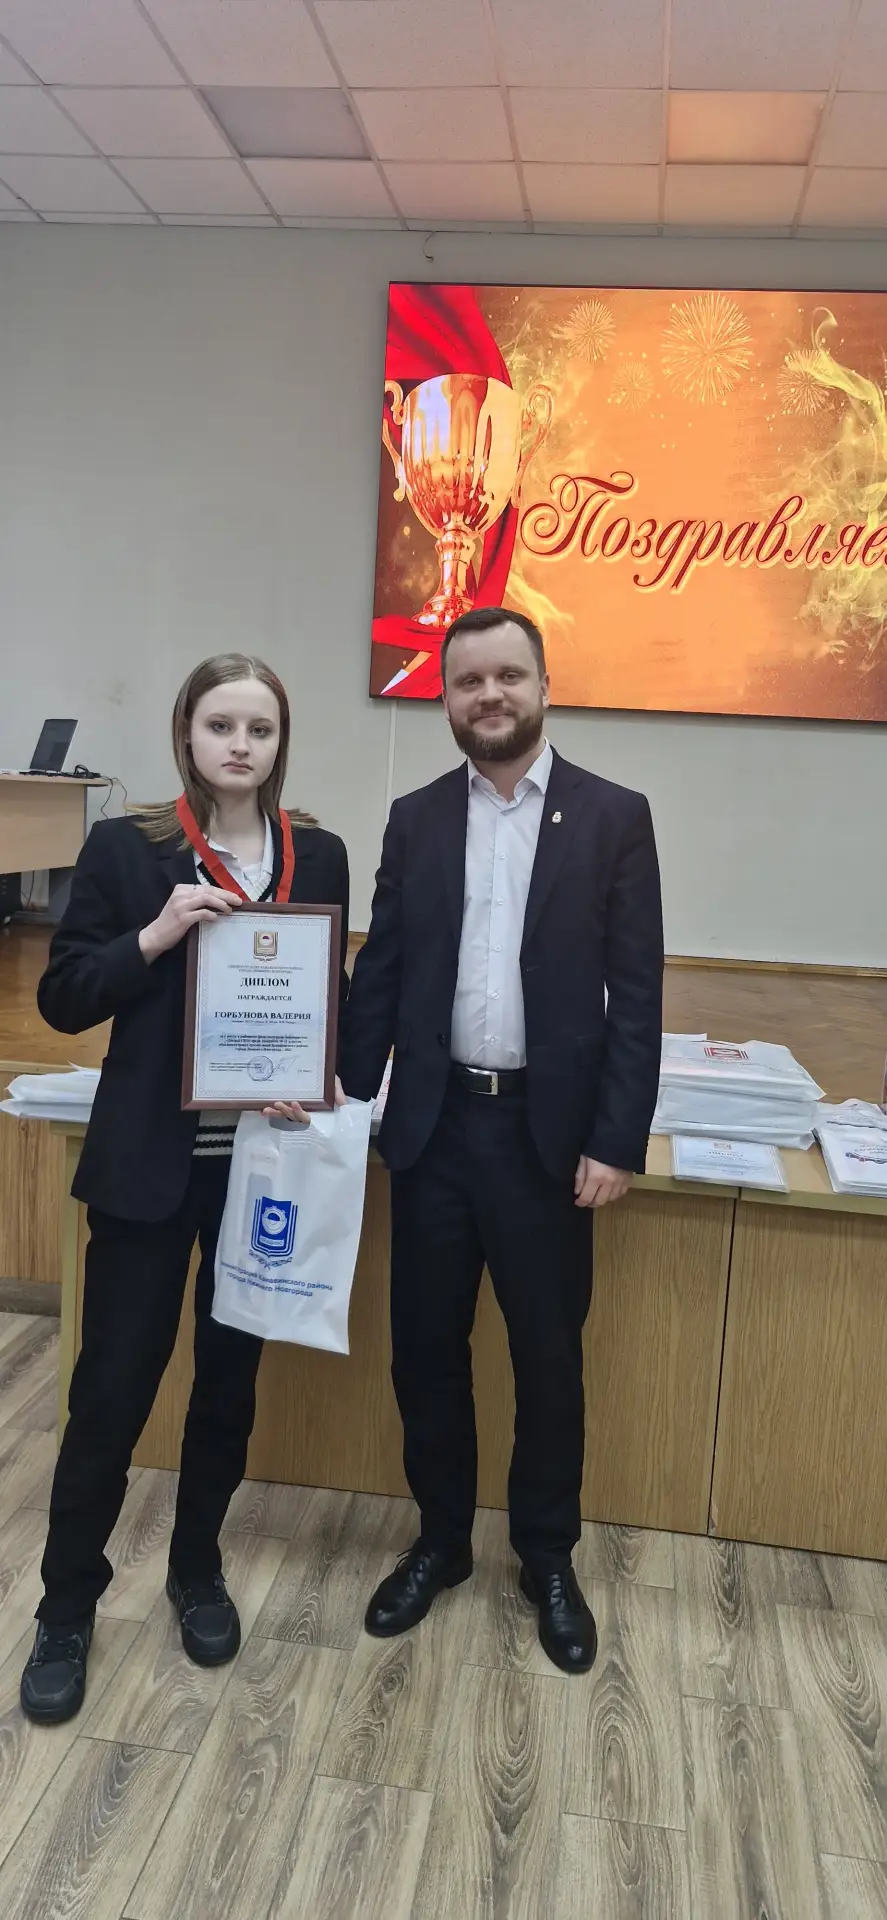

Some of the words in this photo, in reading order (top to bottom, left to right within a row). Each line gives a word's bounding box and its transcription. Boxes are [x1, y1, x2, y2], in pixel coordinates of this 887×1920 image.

[519, 471, 887, 590] Поздравляе
[240, 977, 289, 988] ДИПЛОМ
[237, 994, 292, 1002] НАГРАЖДАЕТСЯ
[214, 1011, 268, 1019] ГОРБУНОВА
[270, 1012, 312, 1020] ВАЛЕРИЯ
[226, 1271, 246, 1283] города
[274, 1285, 313, 1297] Новгорода
[307, 1280, 333, 1291] района
